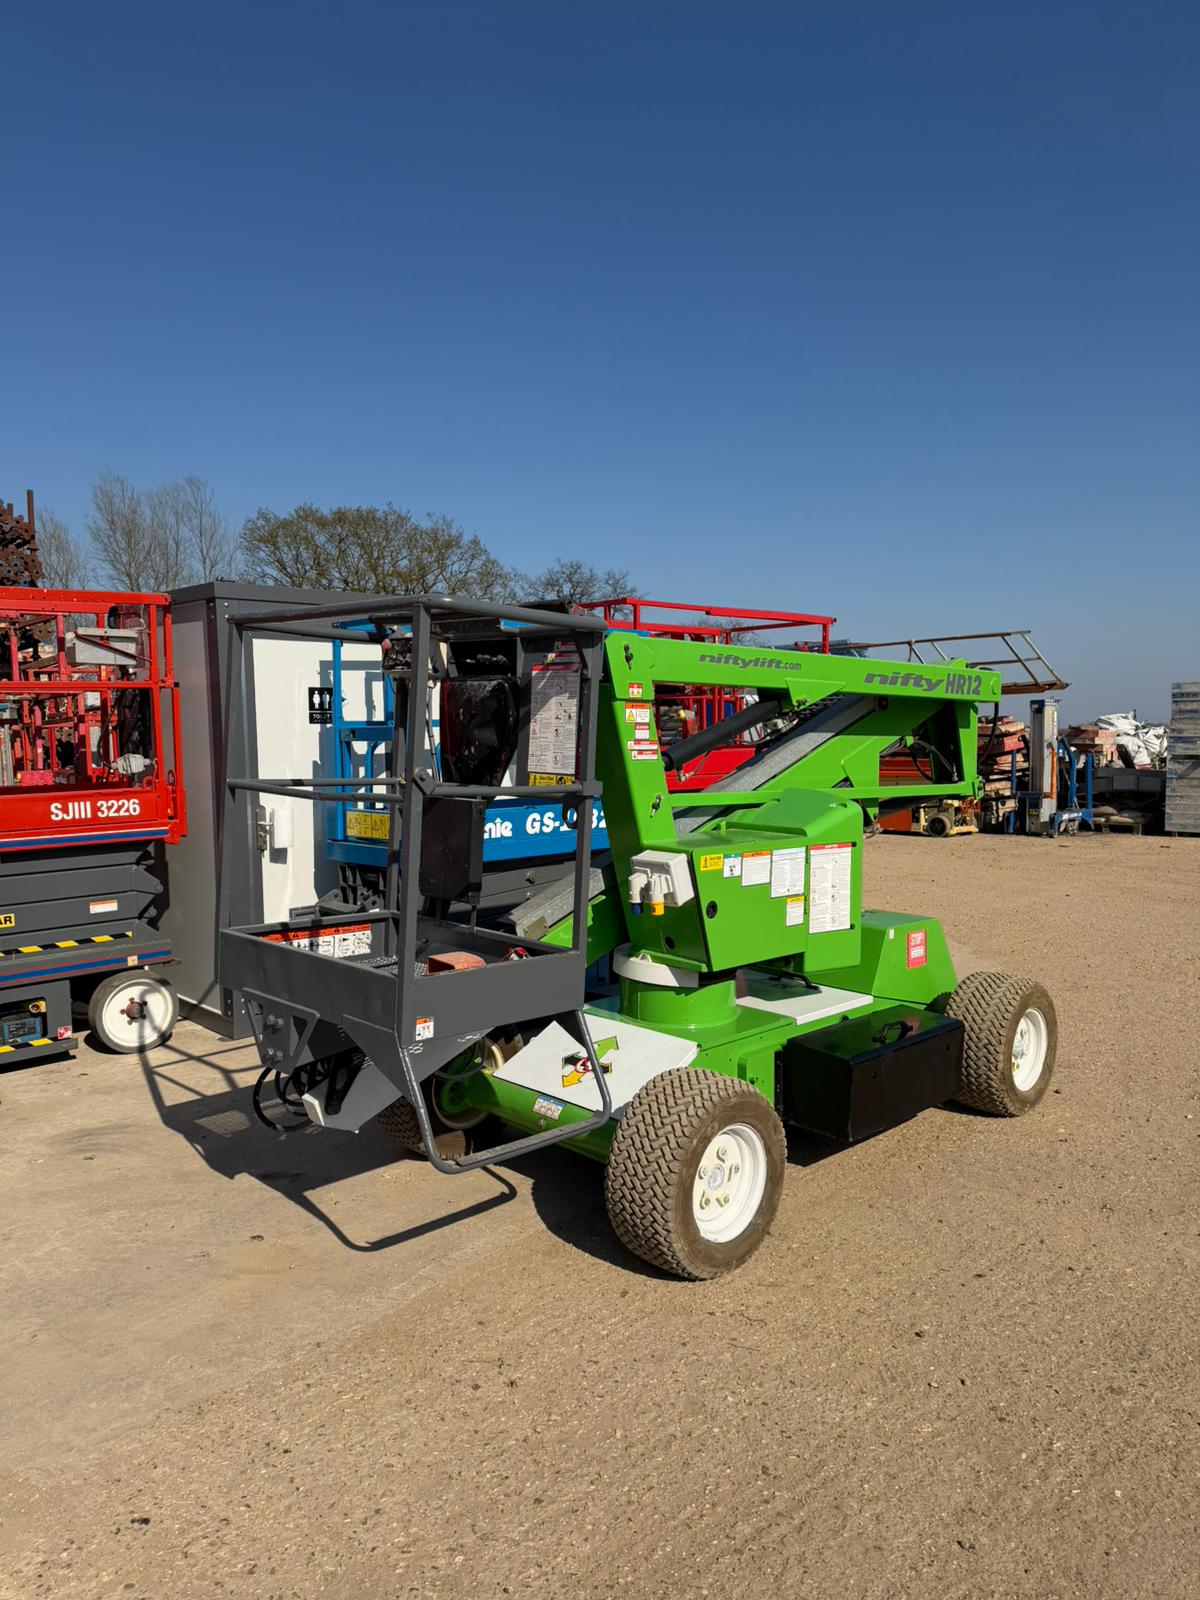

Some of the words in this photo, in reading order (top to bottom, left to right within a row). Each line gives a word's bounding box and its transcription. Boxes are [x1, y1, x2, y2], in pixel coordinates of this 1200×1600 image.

[699, 653, 802, 671] niftylift.com
[864, 671, 944, 692] nifty
[944, 673, 982, 696] HR12
[97, 799, 140, 818] 3226
